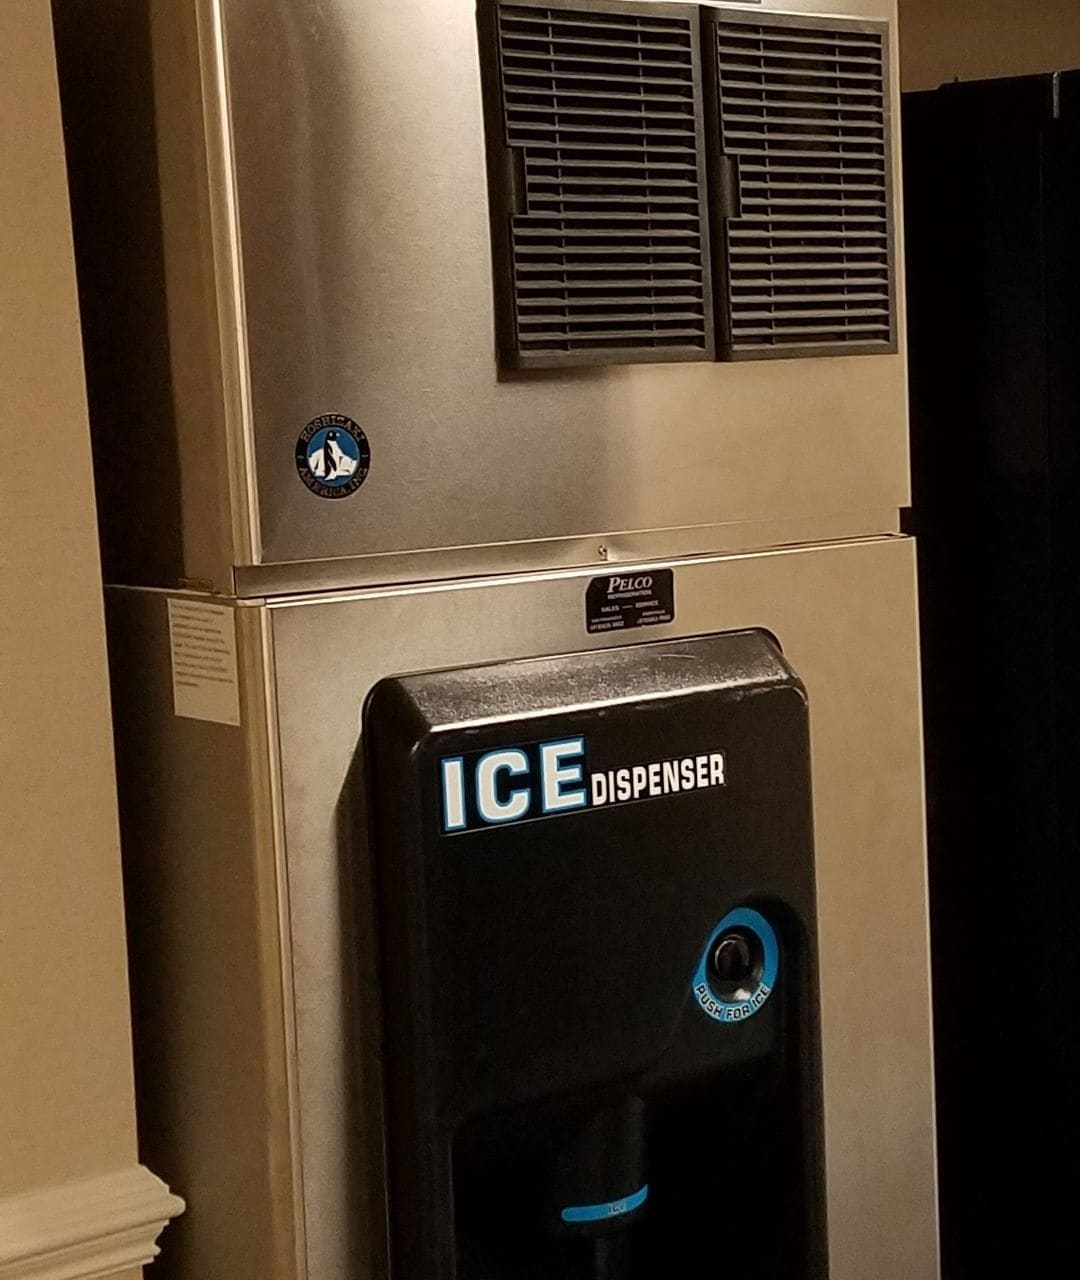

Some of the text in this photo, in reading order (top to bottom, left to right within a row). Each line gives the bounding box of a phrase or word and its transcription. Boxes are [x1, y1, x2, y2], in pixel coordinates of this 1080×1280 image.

[606, 575, 653, 594] PELCO
[441, 734, 725, 833] ICE DISPENSER
[695, 984, 770, 1020] PUSH FOR ICE
